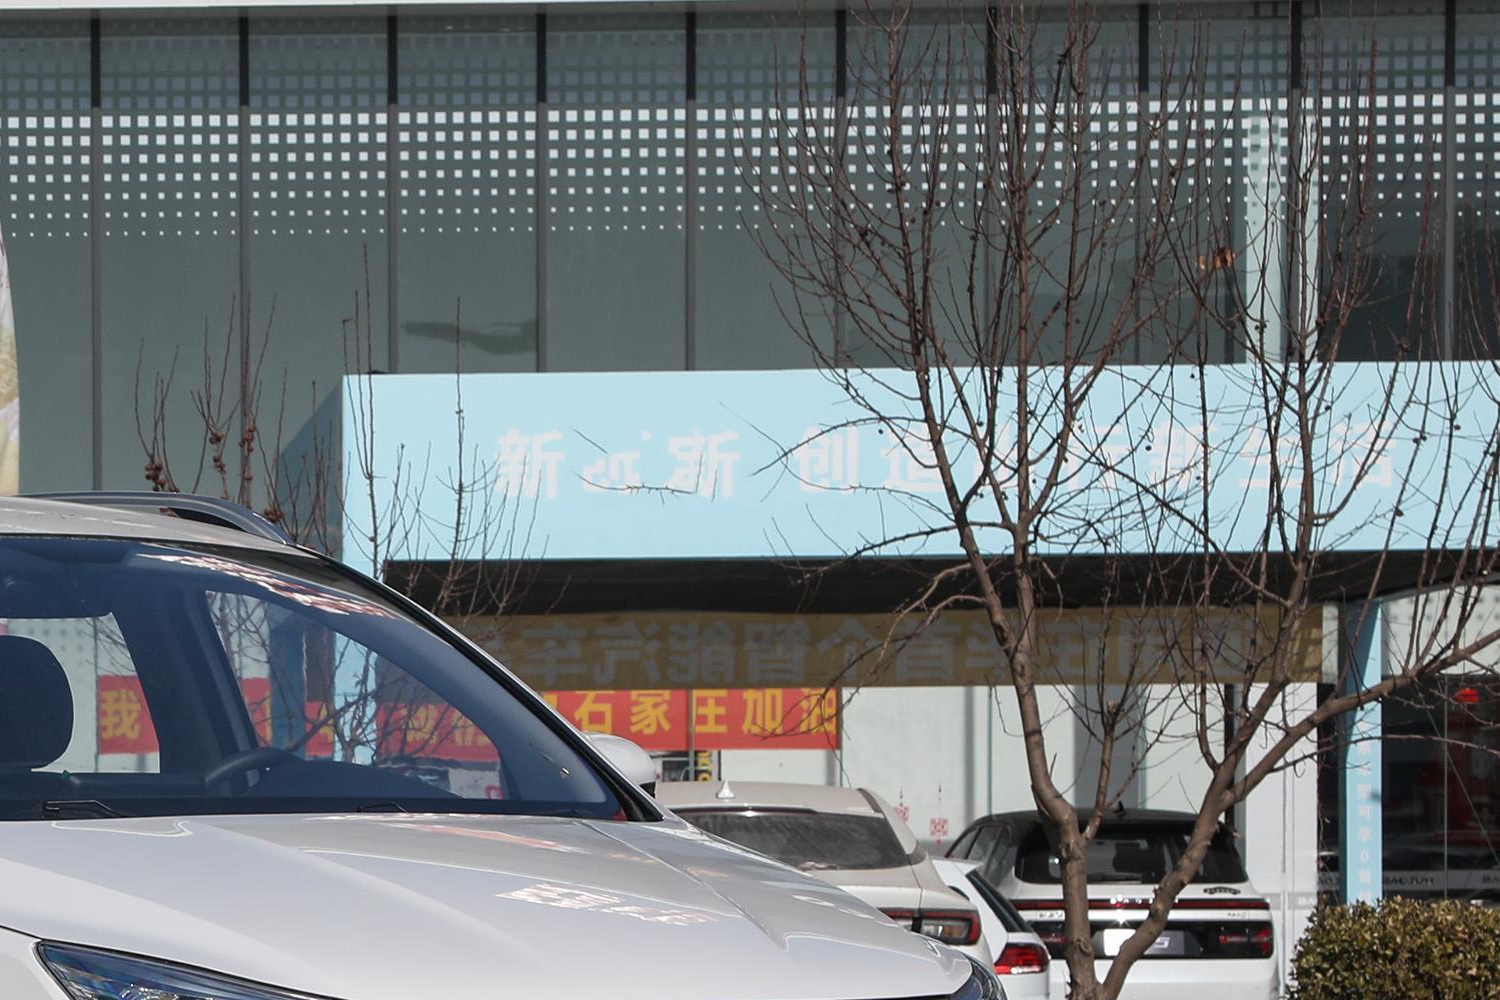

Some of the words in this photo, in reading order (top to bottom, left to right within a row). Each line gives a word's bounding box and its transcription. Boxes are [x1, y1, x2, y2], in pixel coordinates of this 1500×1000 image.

[540, 690, 838, 735] 石家庄加油
